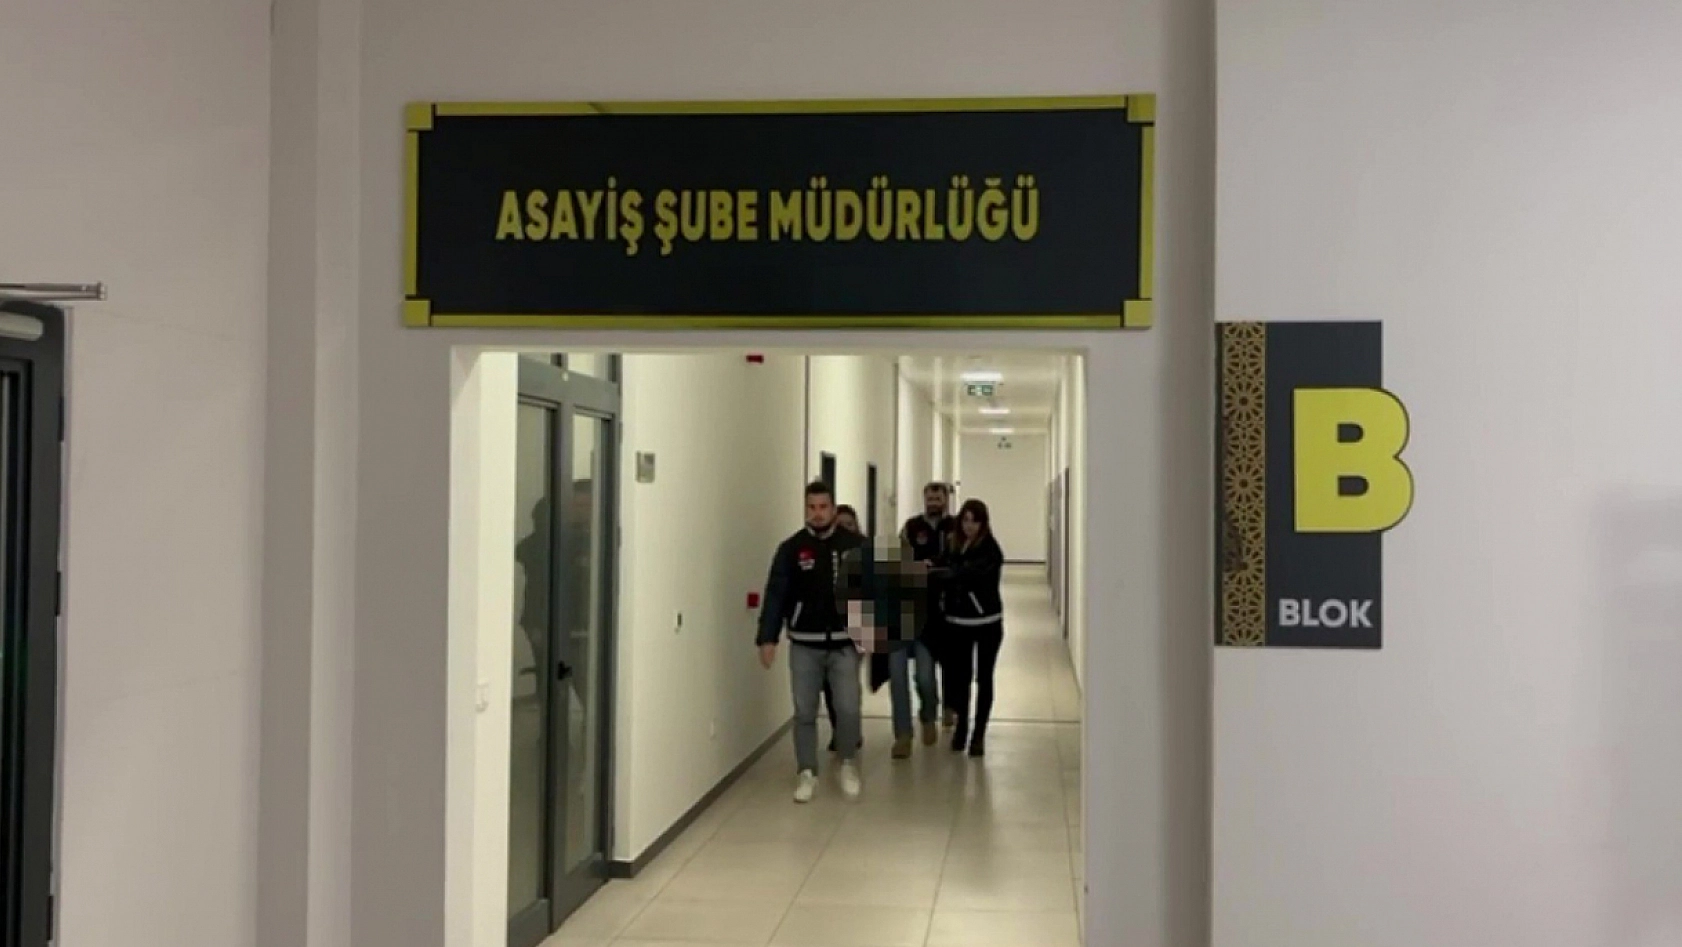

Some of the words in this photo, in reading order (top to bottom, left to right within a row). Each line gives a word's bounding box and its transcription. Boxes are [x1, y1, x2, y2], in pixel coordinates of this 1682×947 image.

[496, 177, 644, 256] ASAYİŞ
[654, 190, 758, 256] ŞUBE
[769, 175, 1039, 241] MÜDÜRLÜĞÜ
[1293, 388, 1414, 532] B
[1277, 598, 1374, 629] BLOK
